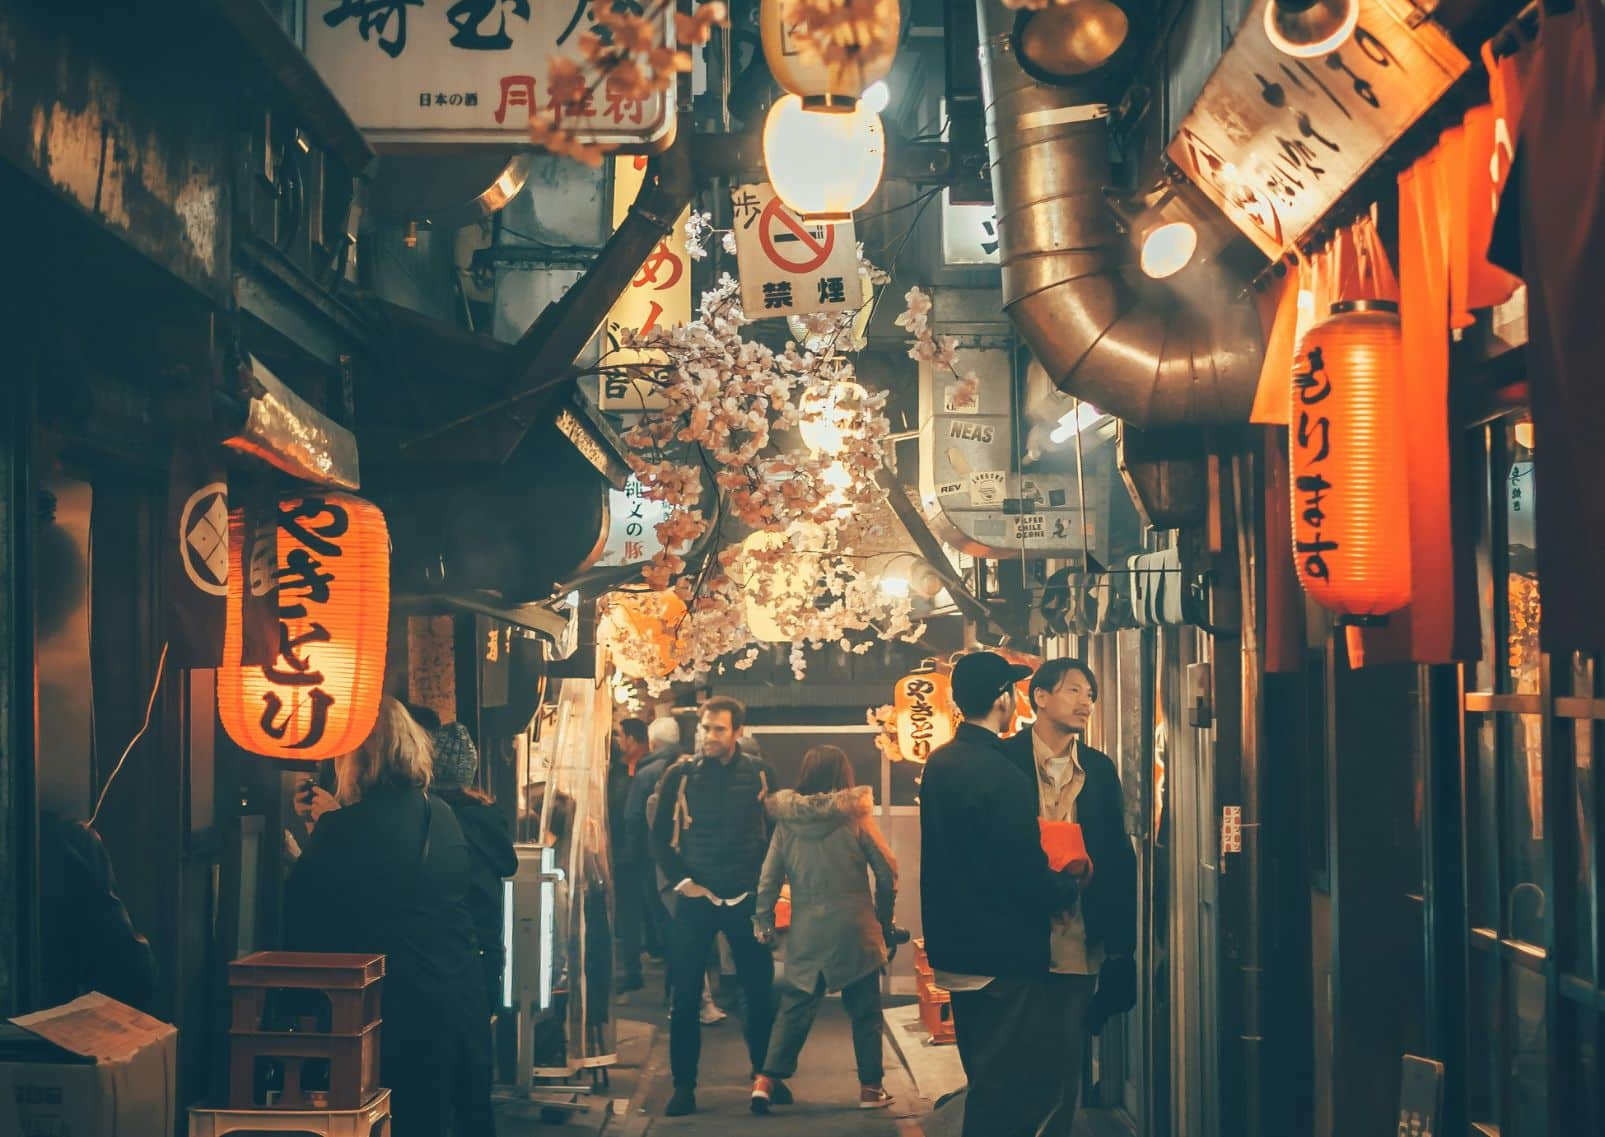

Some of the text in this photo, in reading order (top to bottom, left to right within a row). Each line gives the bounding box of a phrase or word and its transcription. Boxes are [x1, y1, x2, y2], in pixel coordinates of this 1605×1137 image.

[419, 92, 478, 107] 日本の酒
[762, 276, 846, 309] 禁煙
[260, 498, 349, 749] やきとり
